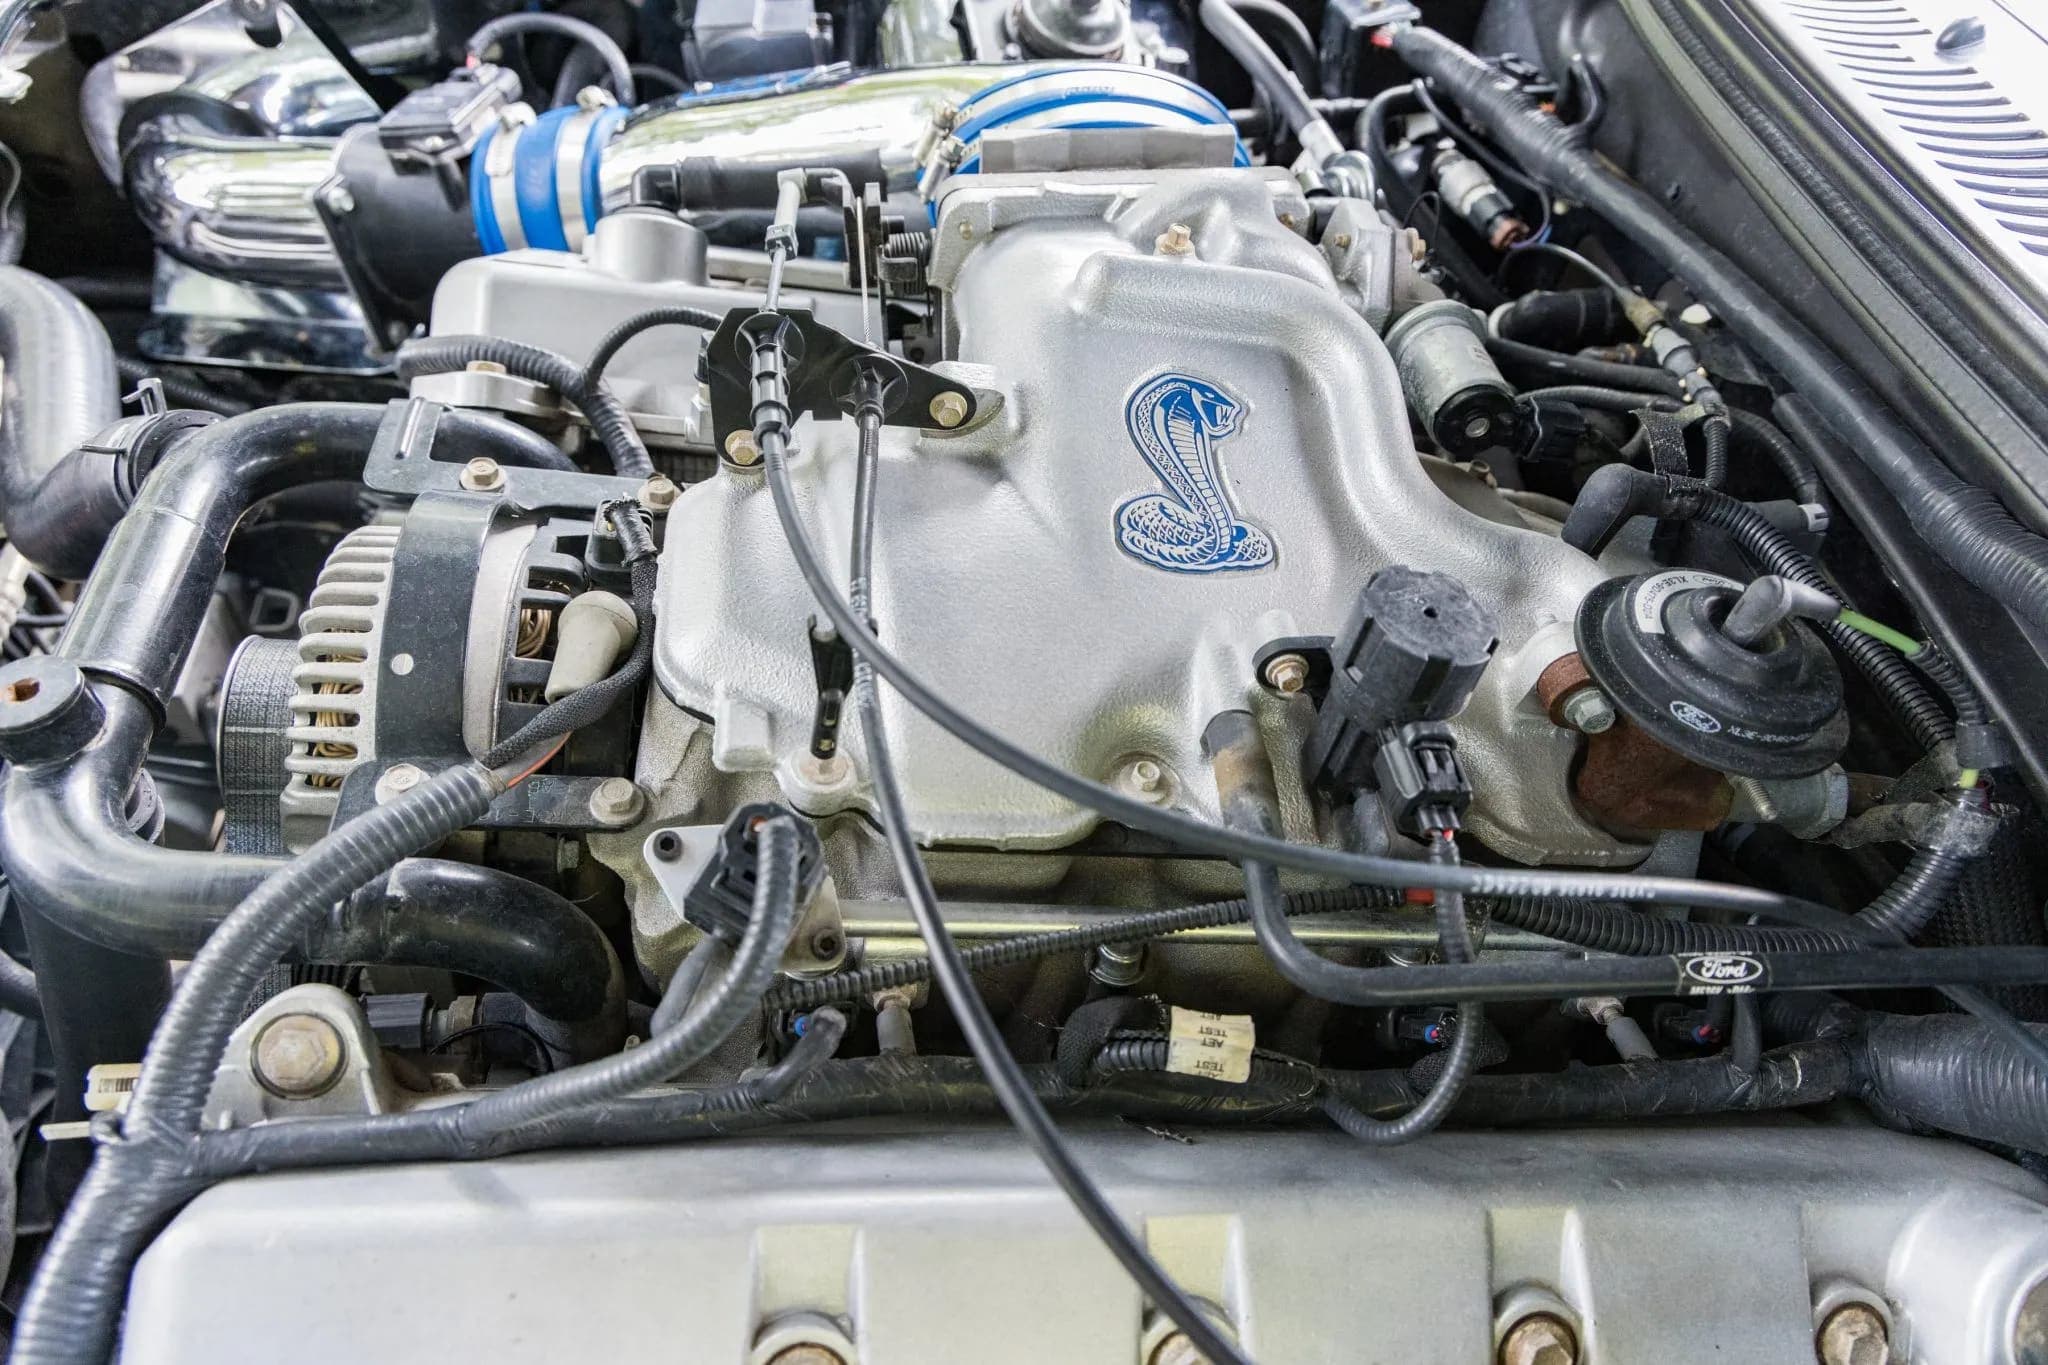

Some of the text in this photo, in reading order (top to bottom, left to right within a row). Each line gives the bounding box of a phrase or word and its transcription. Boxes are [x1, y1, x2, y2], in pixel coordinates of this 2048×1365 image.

[1699, 957, 1750, 979] Ford
[1198, 1025, 1228, 1037] TEST
[1201, 1038, 1224, 1048] AET
[1194, 1060, 1224, 1072] TEST
